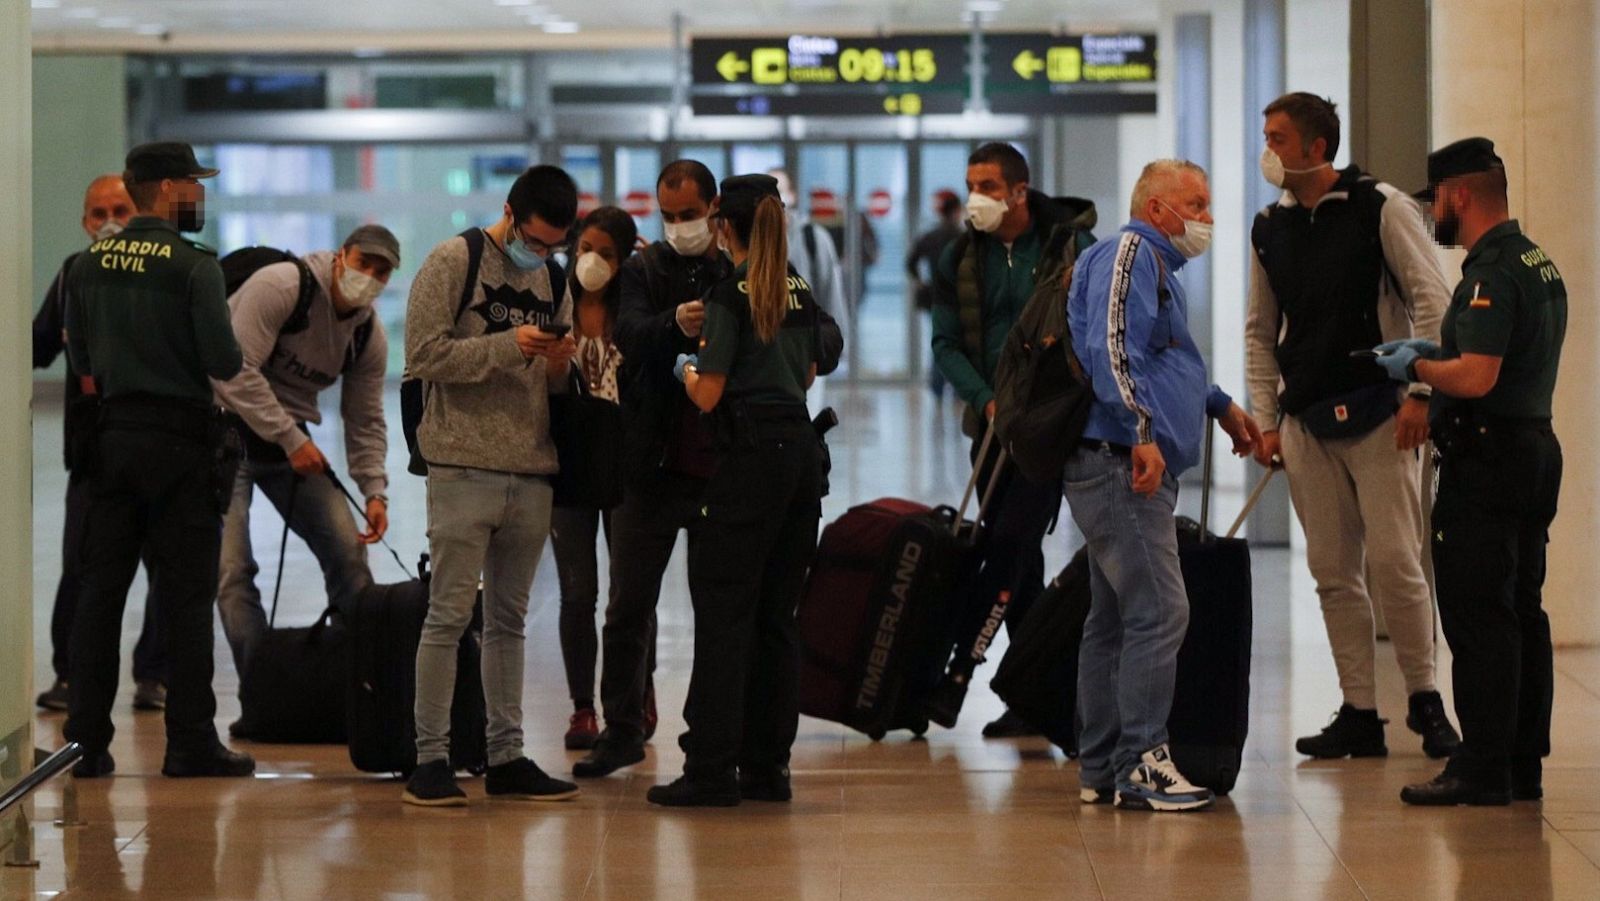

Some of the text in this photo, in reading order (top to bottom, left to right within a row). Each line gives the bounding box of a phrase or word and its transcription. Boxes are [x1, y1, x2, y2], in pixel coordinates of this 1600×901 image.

[90, 239, 172, 258] GUARDIA
[101, 253, 145, 272] CIVIL
[737, 275, 810, 294] GDIA
[856, 541, 922, 709] TIMBERLAND
